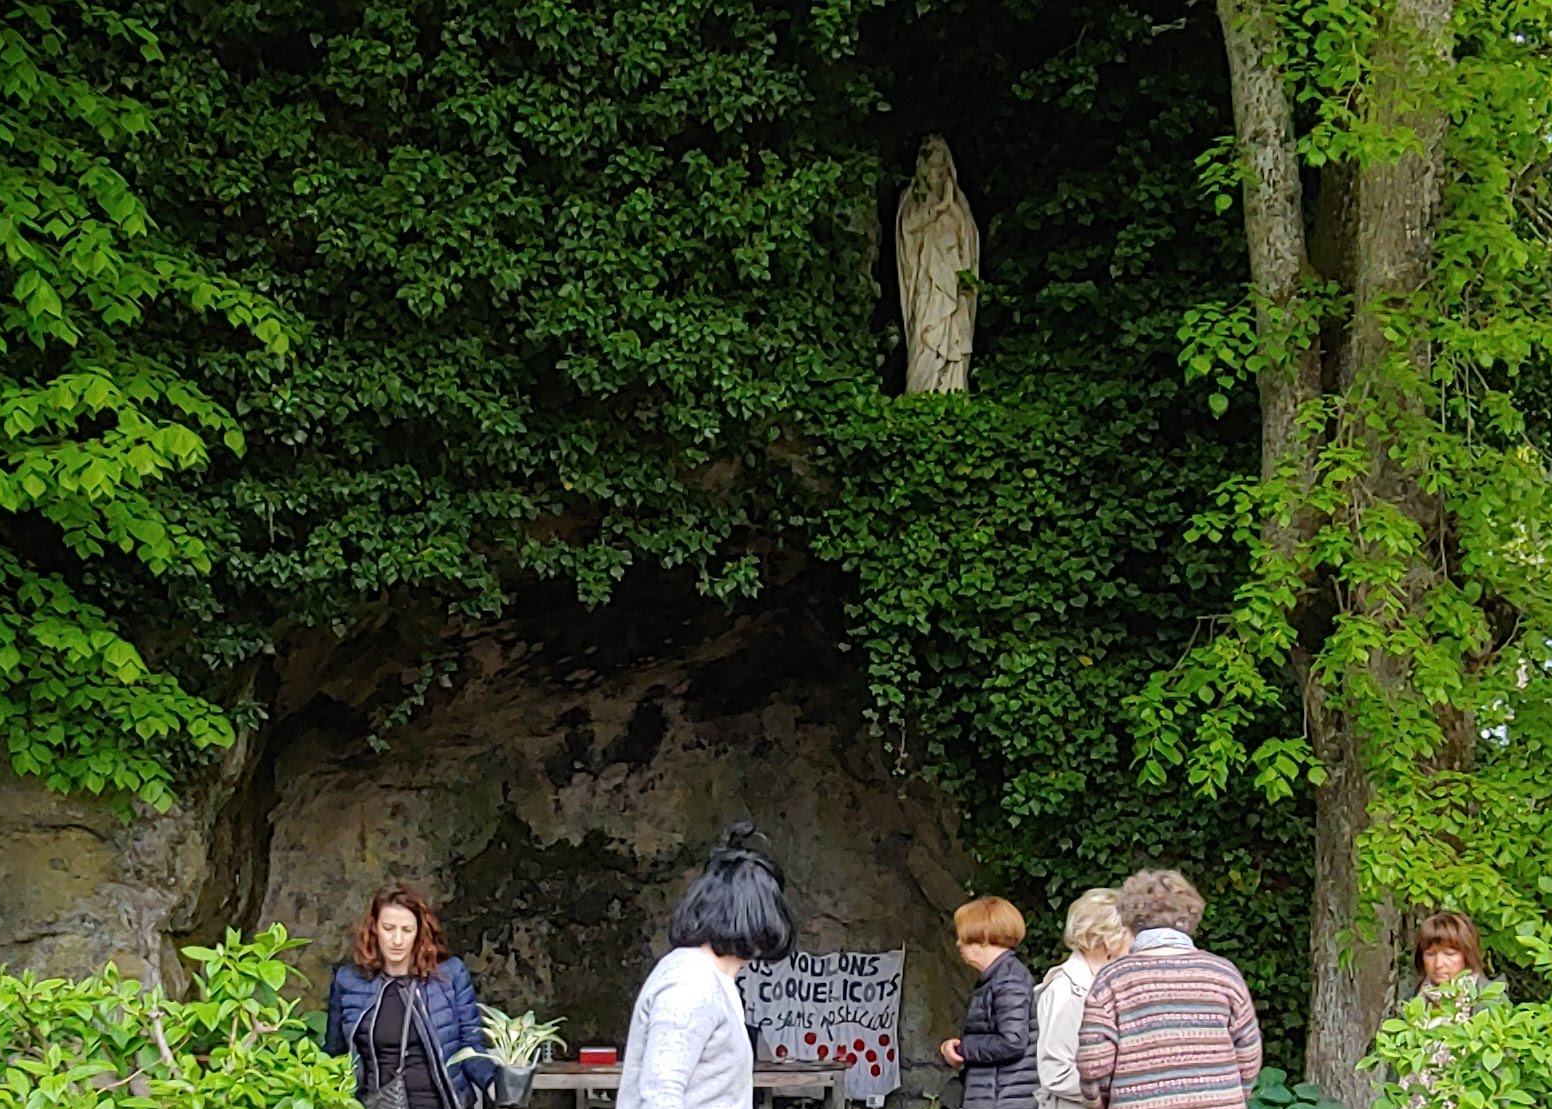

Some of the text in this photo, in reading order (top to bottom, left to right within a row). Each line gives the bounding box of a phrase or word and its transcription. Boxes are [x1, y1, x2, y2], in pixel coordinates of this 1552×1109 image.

[749, 951, 881, 977] US VOULONS
[759, 973, 900, 1003] COQUELICOTS
